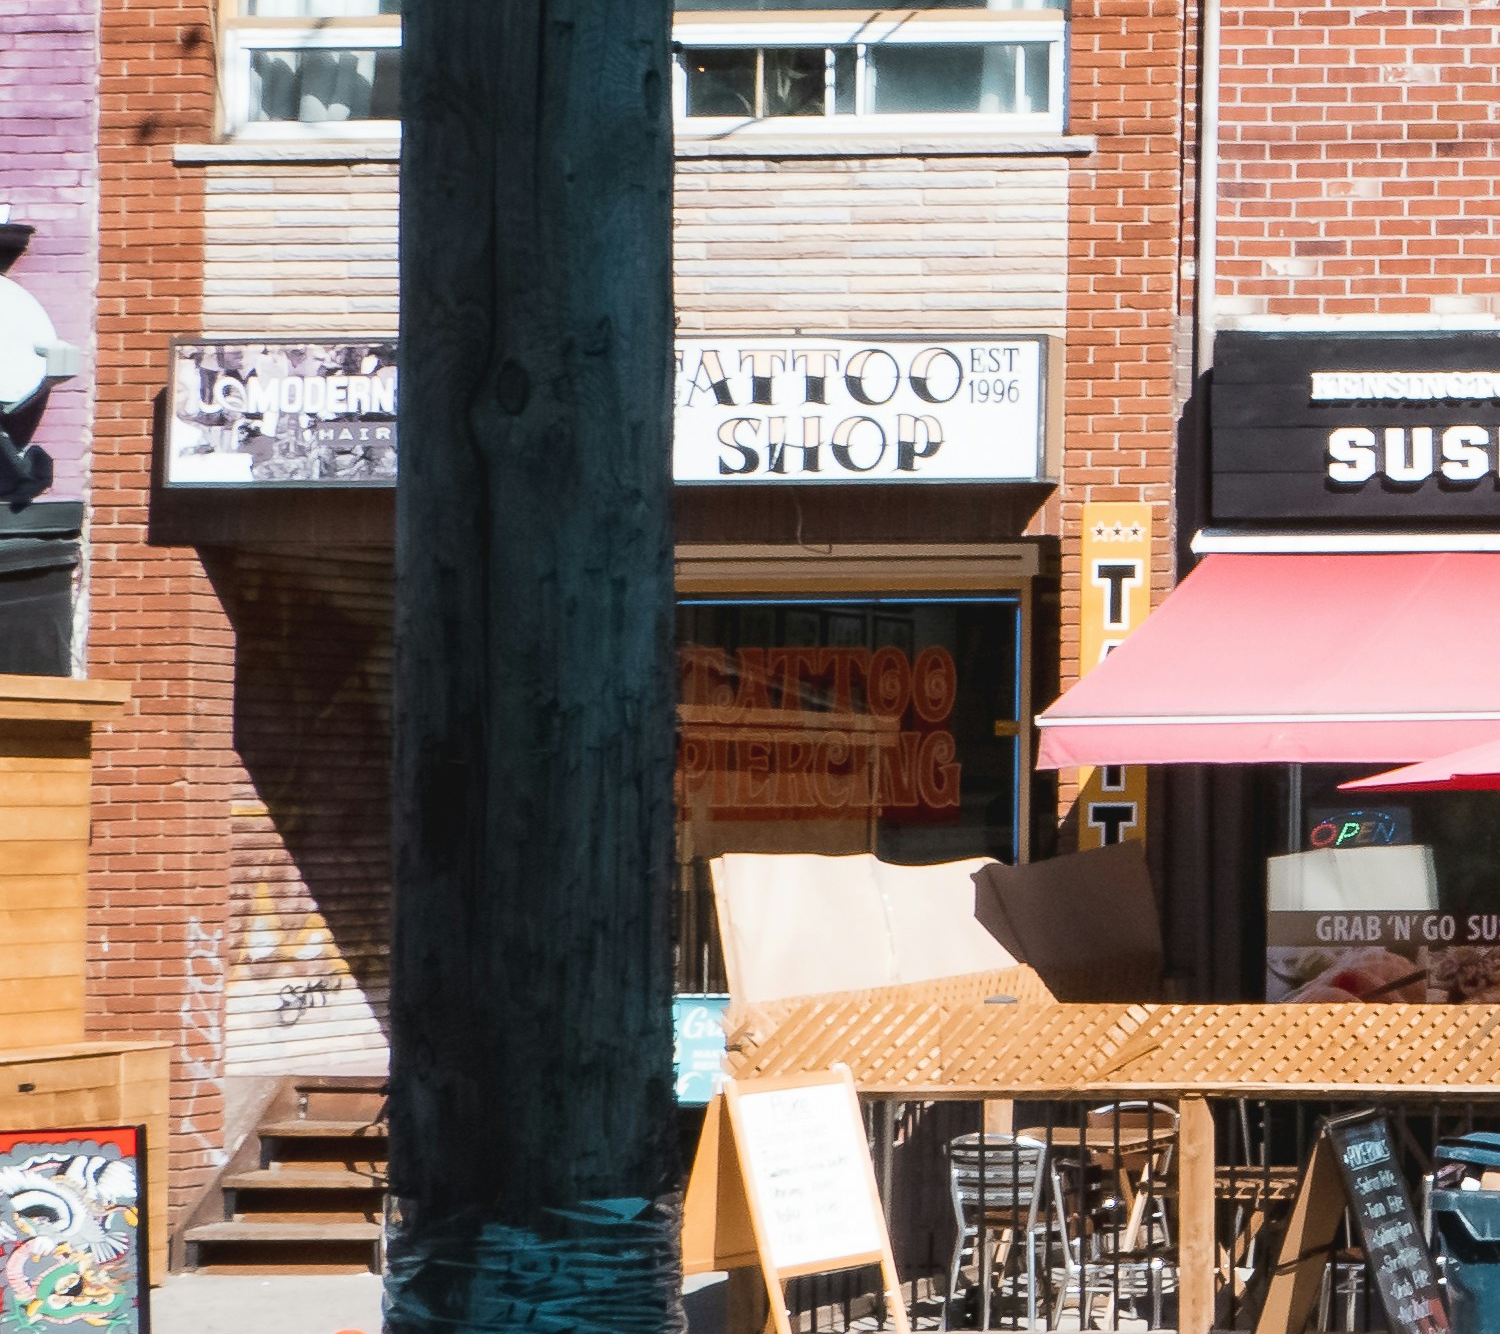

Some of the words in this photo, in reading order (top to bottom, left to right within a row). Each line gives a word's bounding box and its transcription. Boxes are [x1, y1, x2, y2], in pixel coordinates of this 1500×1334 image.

[968, 379, 1020, 404] 1996
[717, 414, 943, 474] SHOP
[679, 646, 957, 723] TATTOO
[679, 731, 961, 808] PIERCING
[1311, 821, 1397, 846] OPEN
[1315, 915, 1381, 941] GRAB
[1422, 915, 1455, 941] GO
